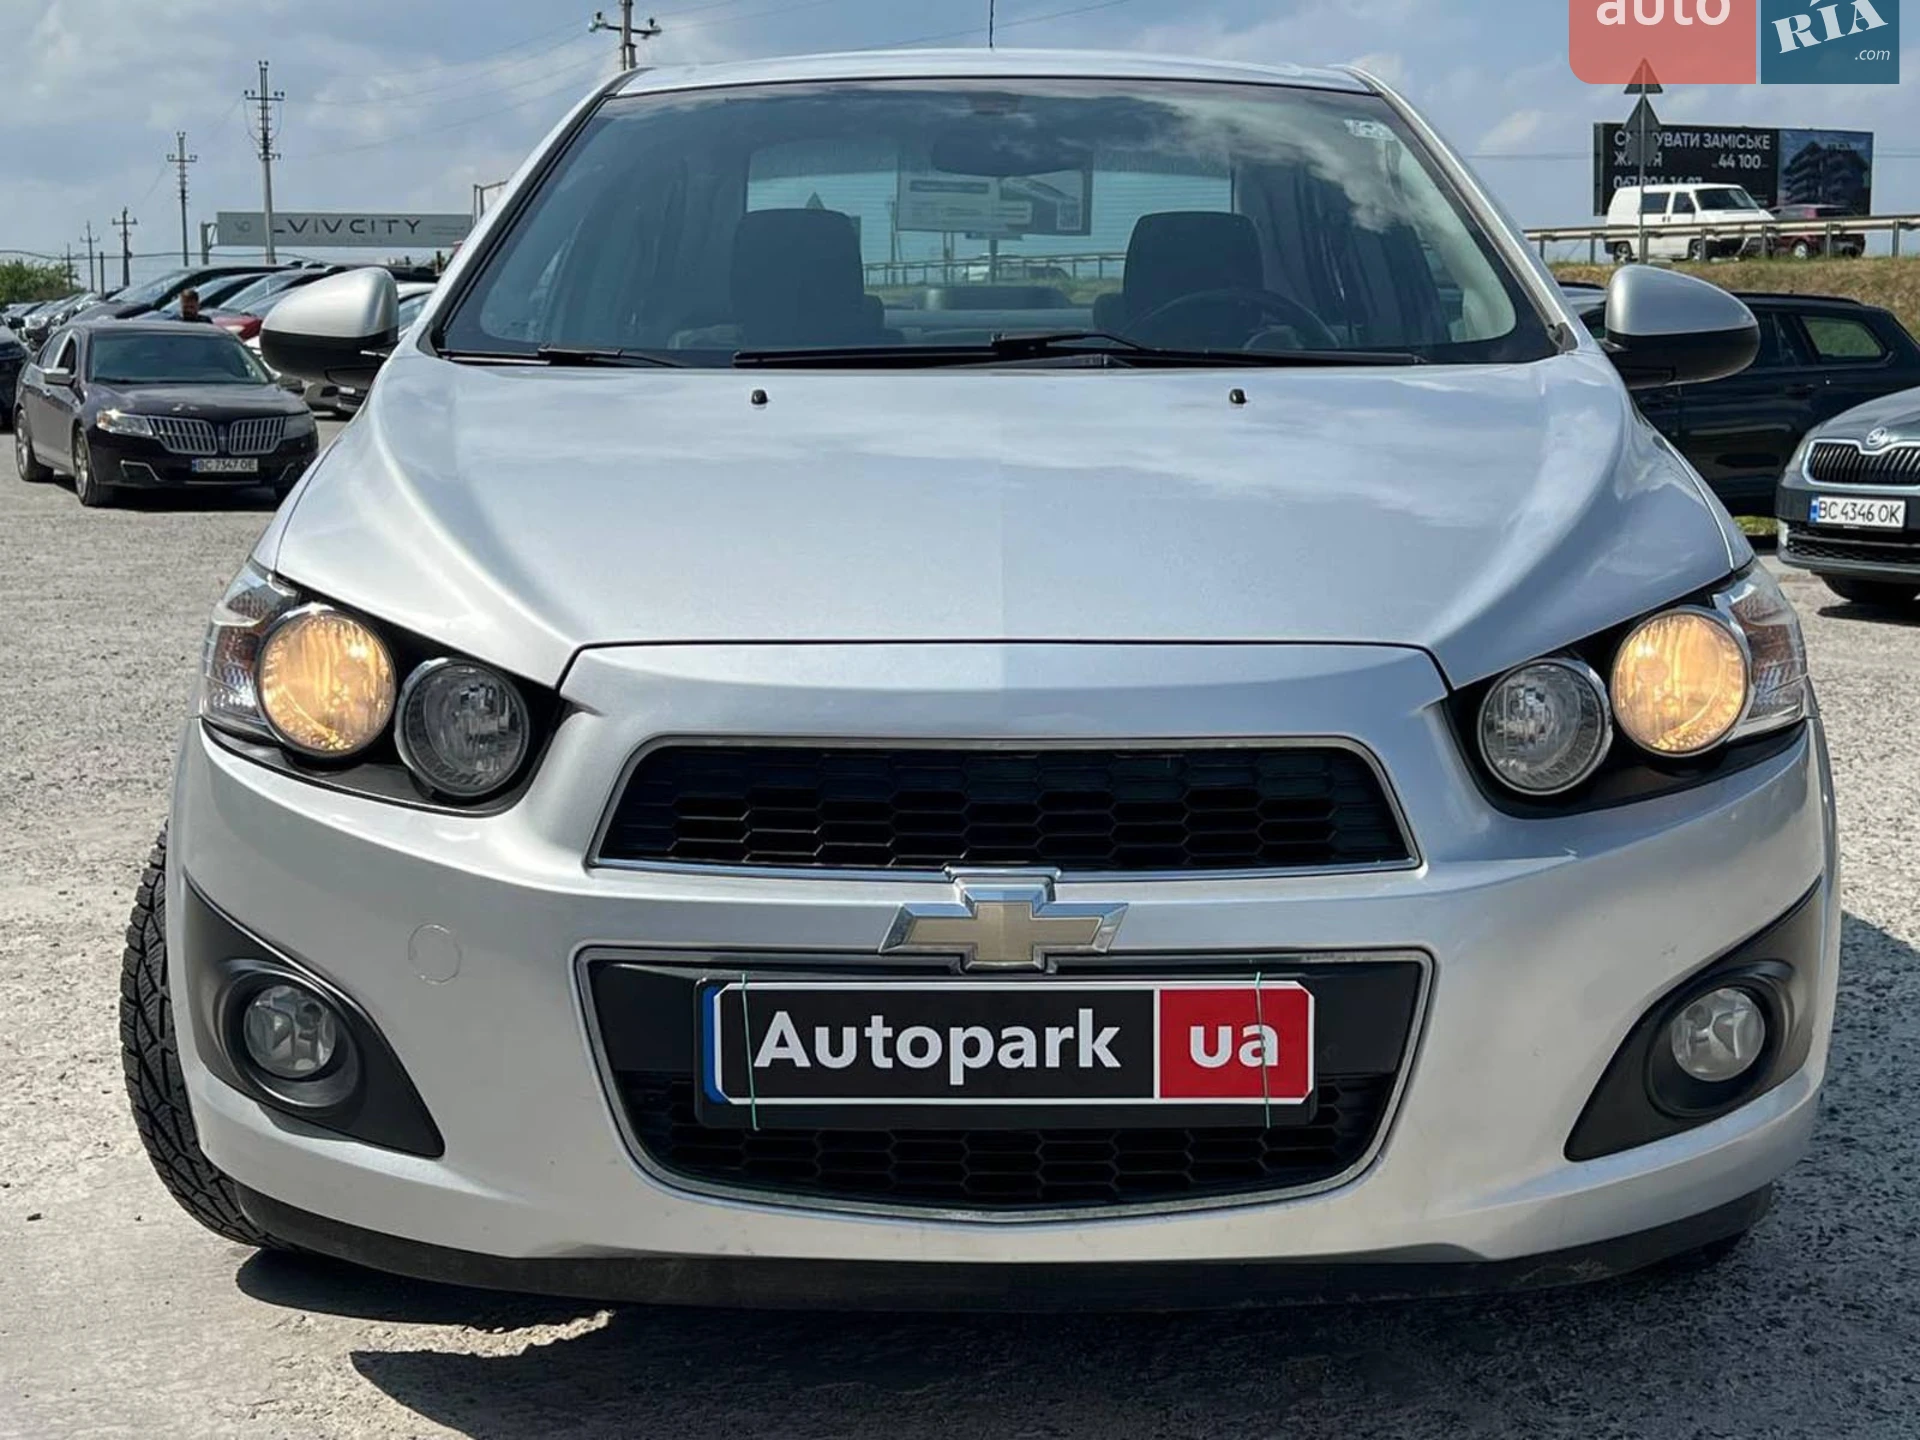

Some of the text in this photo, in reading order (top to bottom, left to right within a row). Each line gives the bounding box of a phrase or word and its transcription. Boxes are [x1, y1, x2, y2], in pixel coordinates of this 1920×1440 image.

[1702, 132, 1771, 150] ЗАМІСЬКЕ
[1718, 153, 1762, 169] 44 100
[1818, 501, 1902, 524] BC 4346 OK
[753, 1008, 1278, 1086] Autopark ua
